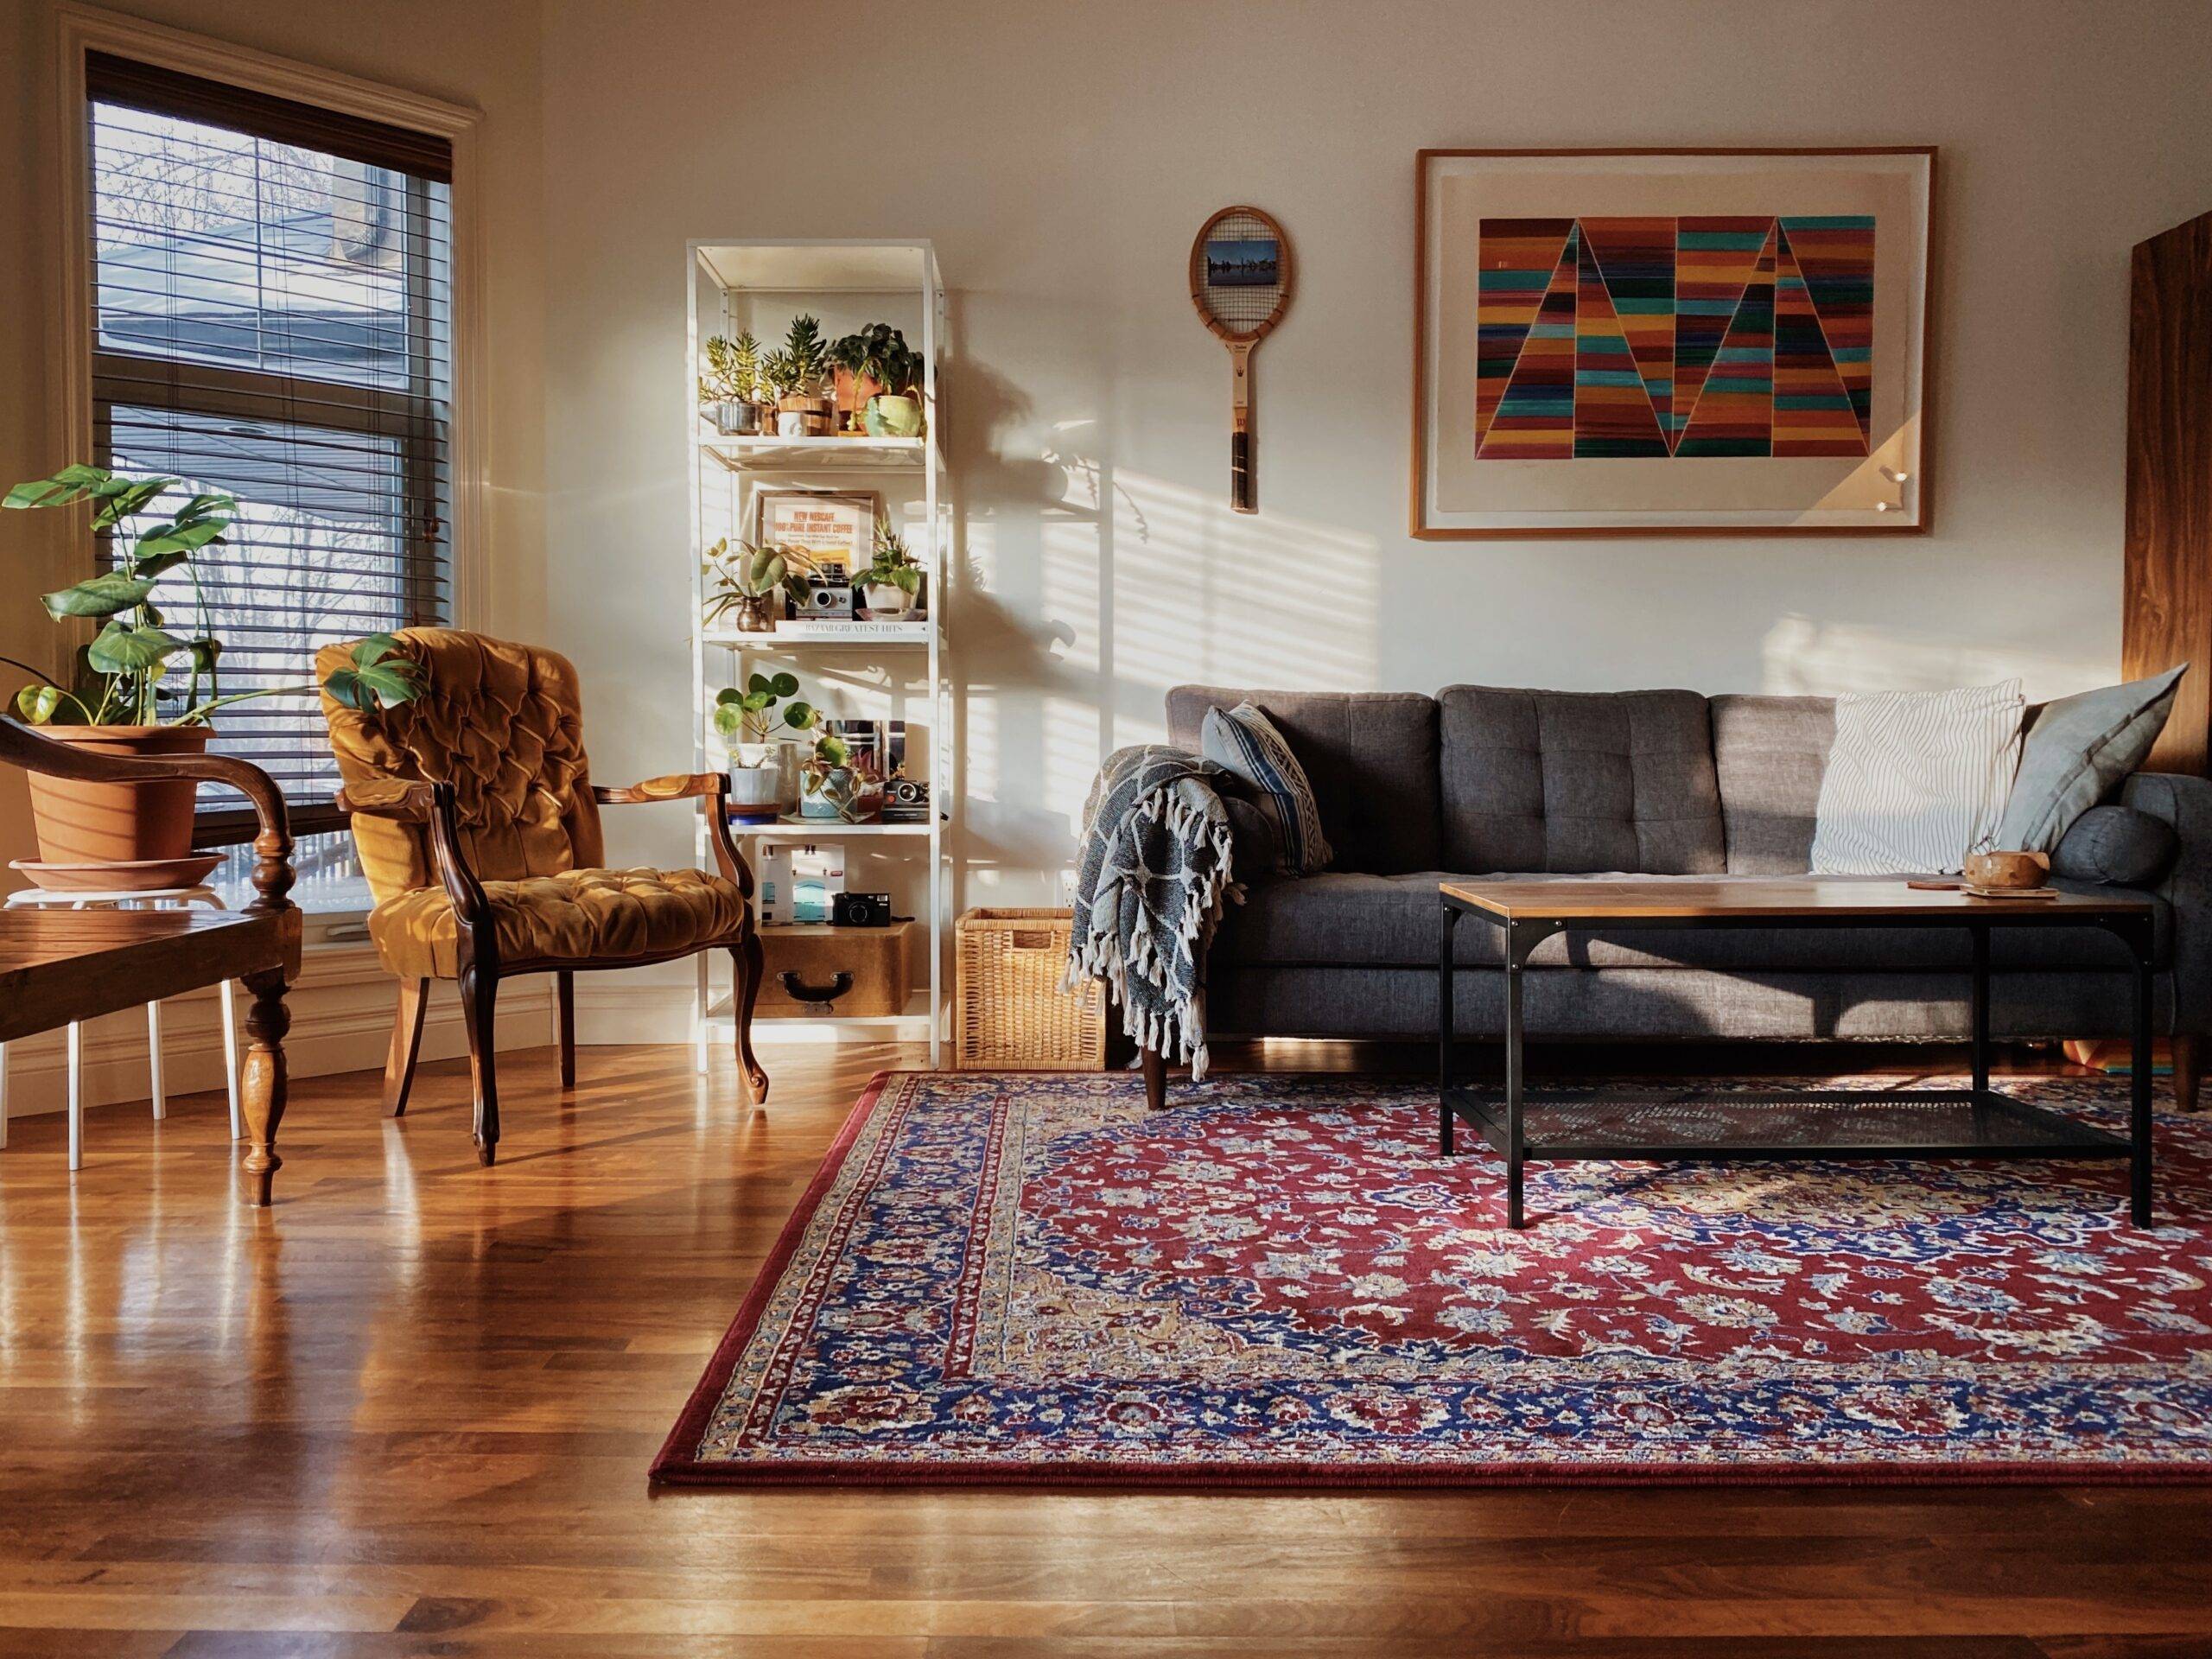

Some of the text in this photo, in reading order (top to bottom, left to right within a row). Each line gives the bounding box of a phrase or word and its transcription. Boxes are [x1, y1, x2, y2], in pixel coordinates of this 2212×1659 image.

[794, 512, 808, 522] NEW
[790, 523, 805, 532] PURE
[807, 524, 831, 532] INSTANT
[833, 524, 853, 533] COFFEE
